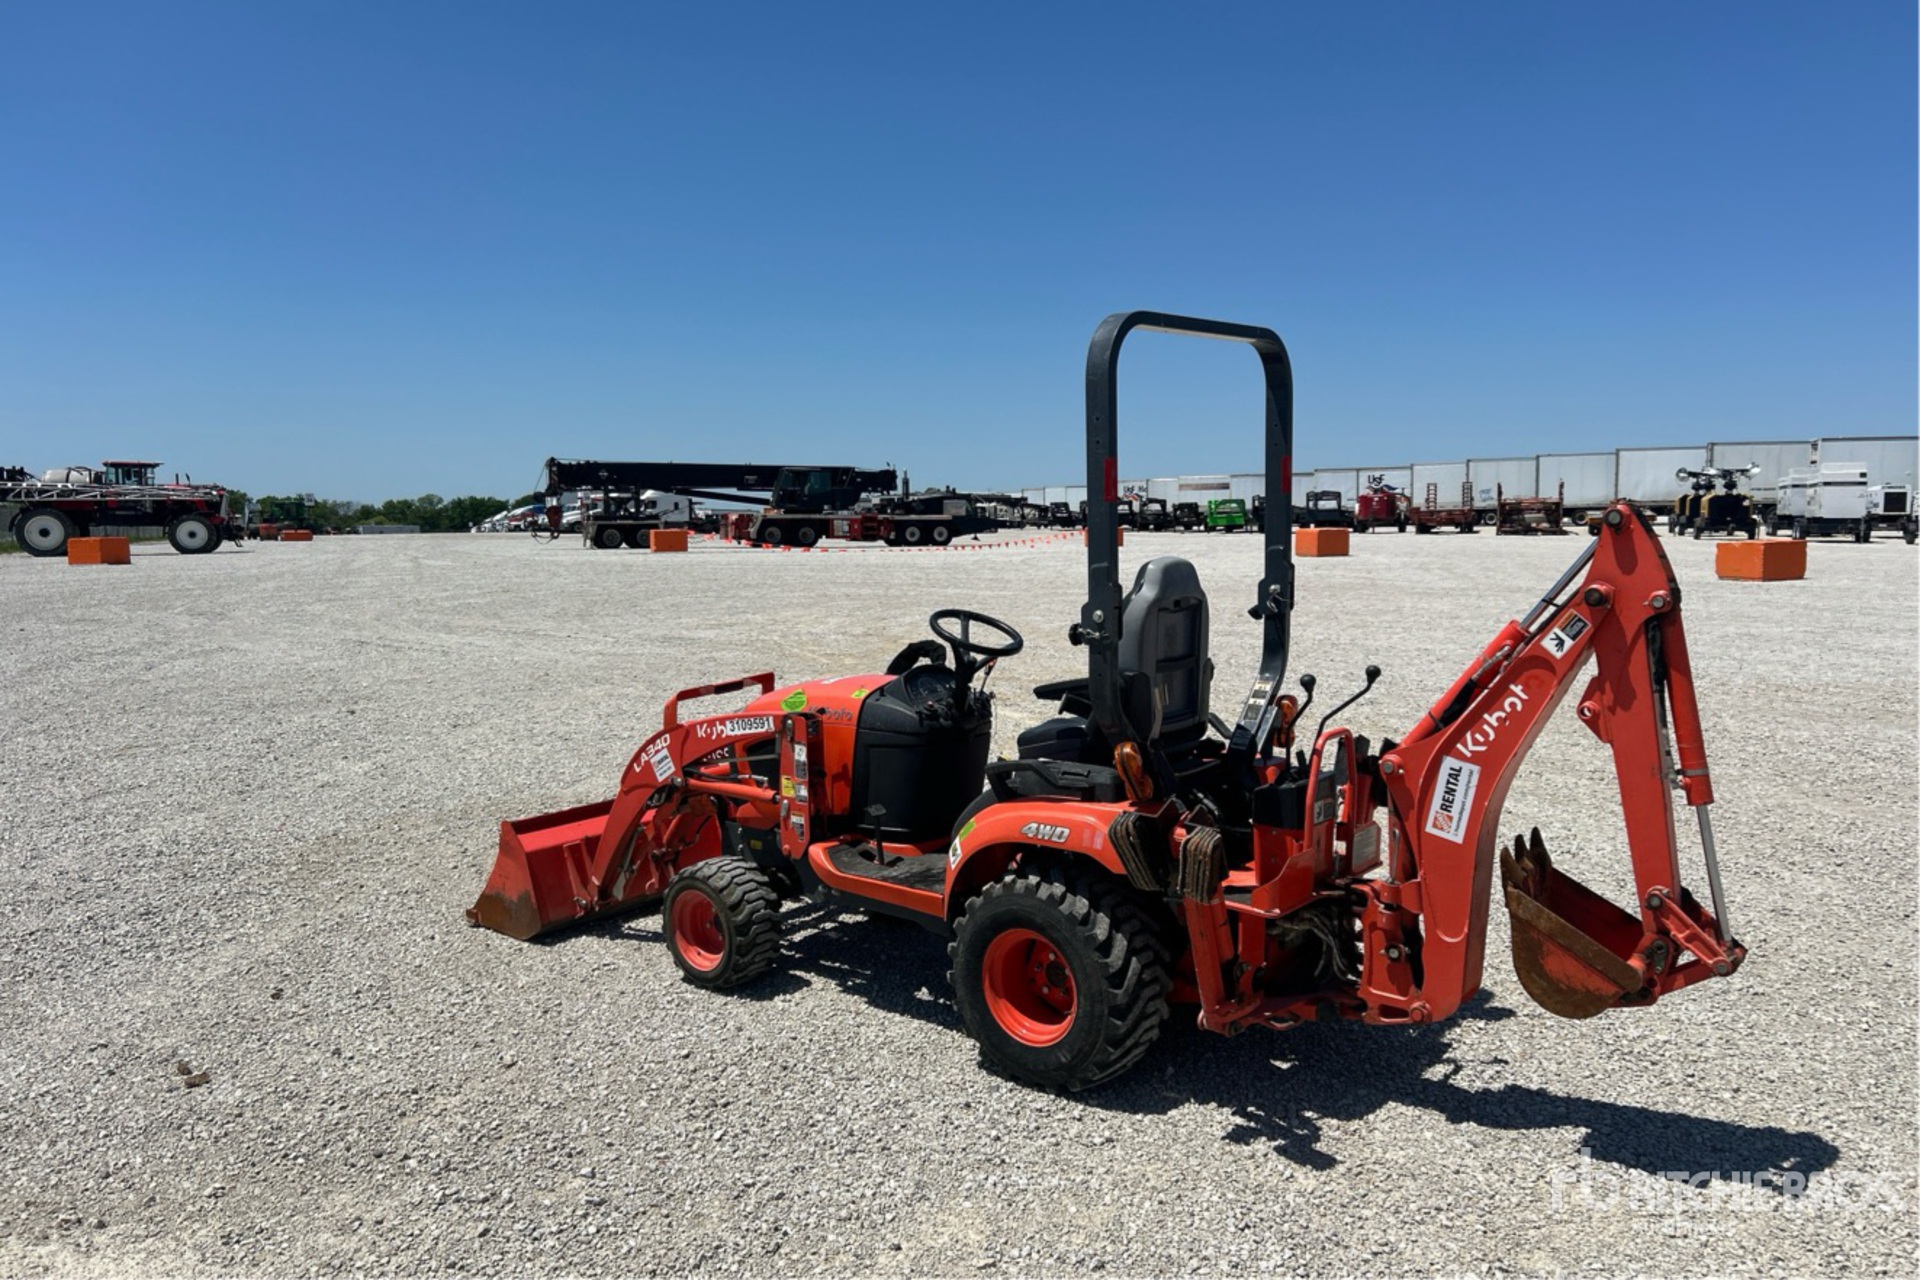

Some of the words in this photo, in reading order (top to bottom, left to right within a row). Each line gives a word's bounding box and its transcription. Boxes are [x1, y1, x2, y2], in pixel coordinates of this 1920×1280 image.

[729, 716, 773, 733] 3109591
[633, 733, 671, 773] LA340
[1440, 766, 1463, 813] RENTAL
[1021, 822, 1070, 843] 4WD
